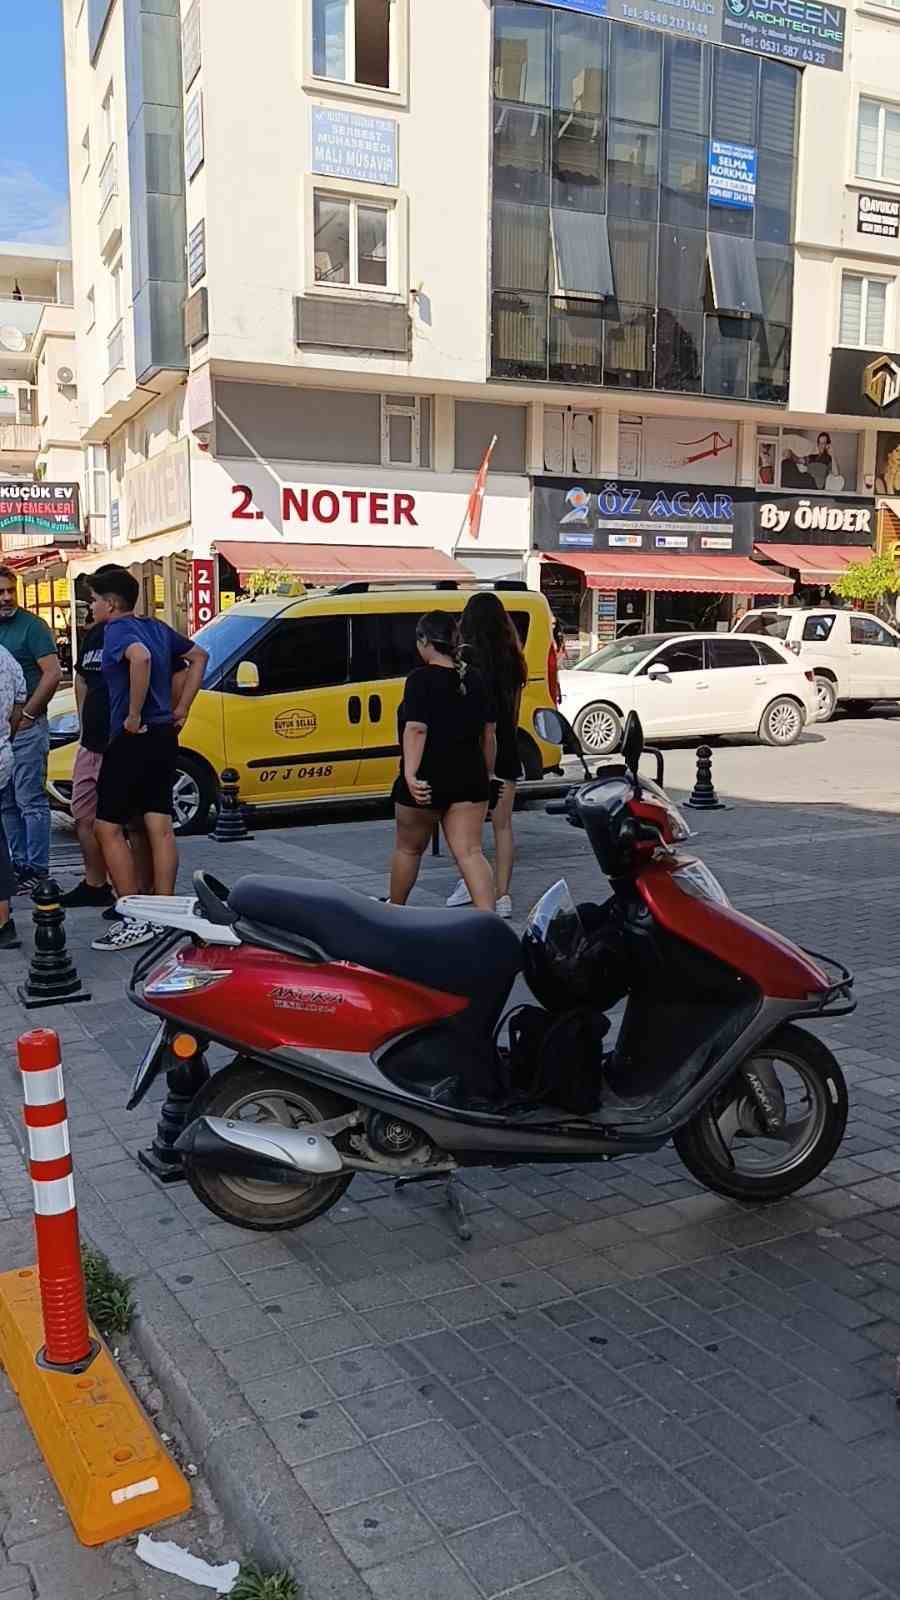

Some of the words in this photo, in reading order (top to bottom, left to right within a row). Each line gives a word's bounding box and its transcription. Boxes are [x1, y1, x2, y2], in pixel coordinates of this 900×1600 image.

[747, 10, 843, 42] ARCHITECTURE
[719, 155, 748, 171] SELMA
[711, 164, 753, 182] KORKMAZ
[0, 484, 51, 501] KÜÇÜK
[54, 487, 73, 498] EV
[599, 482, 641, 515] ÖZ
[648, 490, 735, 520] ACAR
[0, 502, 13, 514] EV
[15, 500, 75, 514] YEMEKLERİ
[231, 484, 264, 520] 2.
[282, 487, 419, 527] NOTER
[759, 503, 791, 532] By
[794, 500, 871, 533] ÖNDER
[198, 569, 211, 584] 2
[260, 770, 277, 782] 07
[282, 768, 293, 780] J
[298, 765, 333, 779] 0448
